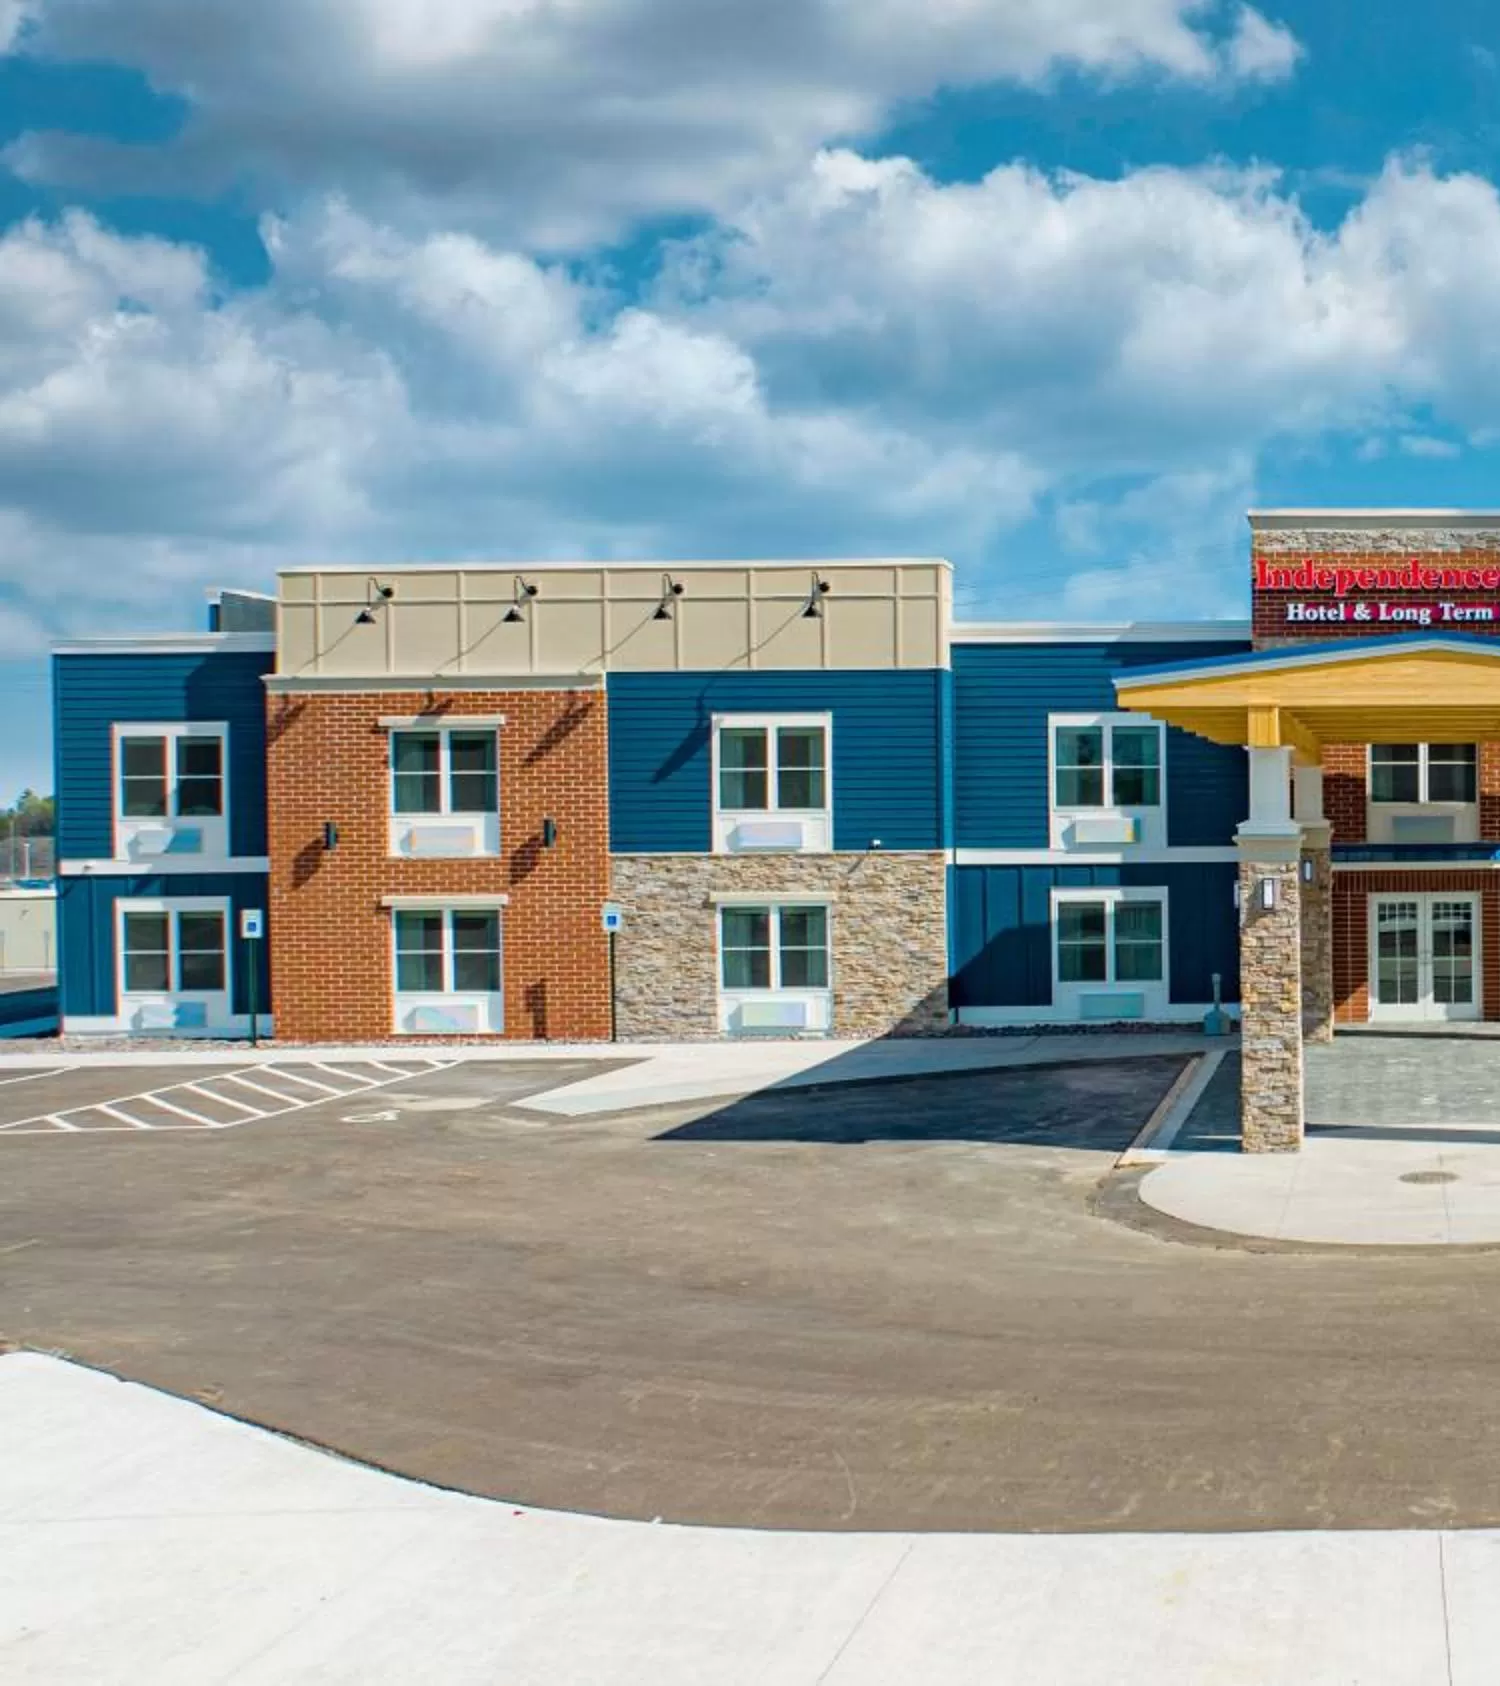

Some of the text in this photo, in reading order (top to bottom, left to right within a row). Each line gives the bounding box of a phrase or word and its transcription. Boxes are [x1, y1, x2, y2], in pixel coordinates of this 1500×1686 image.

[1255, 558, 1500, 596] Independence
[1286, 603, 1345, 621] Hotel
[1353, 604, 1371, 621] &
[1379, 603, 1432, 625] Long
[1439, 603, 1494, 620] Term
